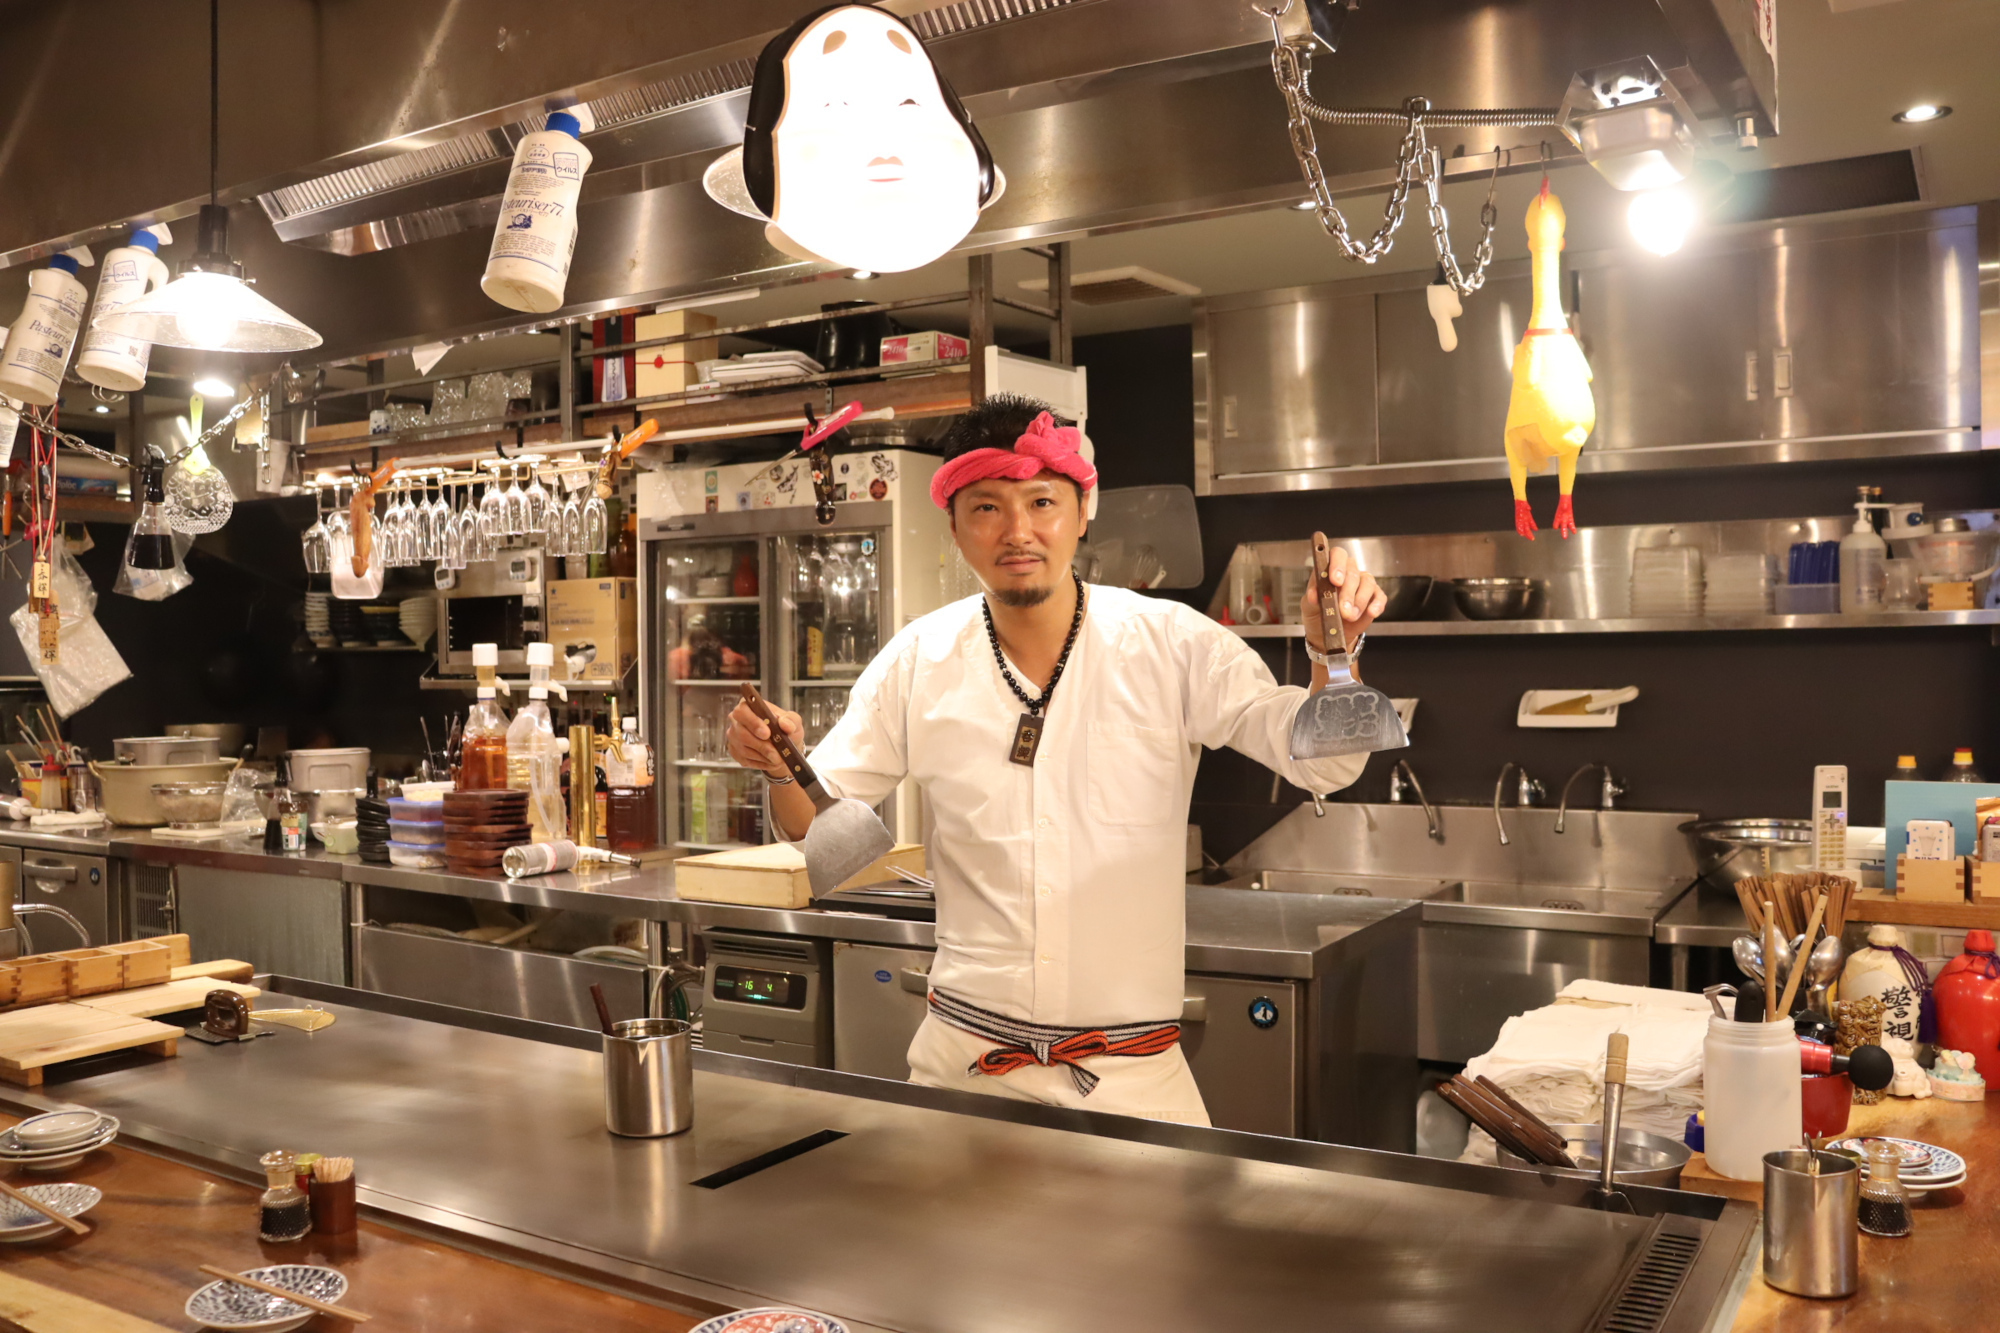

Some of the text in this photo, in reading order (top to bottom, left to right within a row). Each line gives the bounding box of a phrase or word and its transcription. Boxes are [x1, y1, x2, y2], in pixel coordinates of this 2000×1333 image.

[556, 166, 578, 175] ウイルス
[944, 345, 963, 358] 2410
